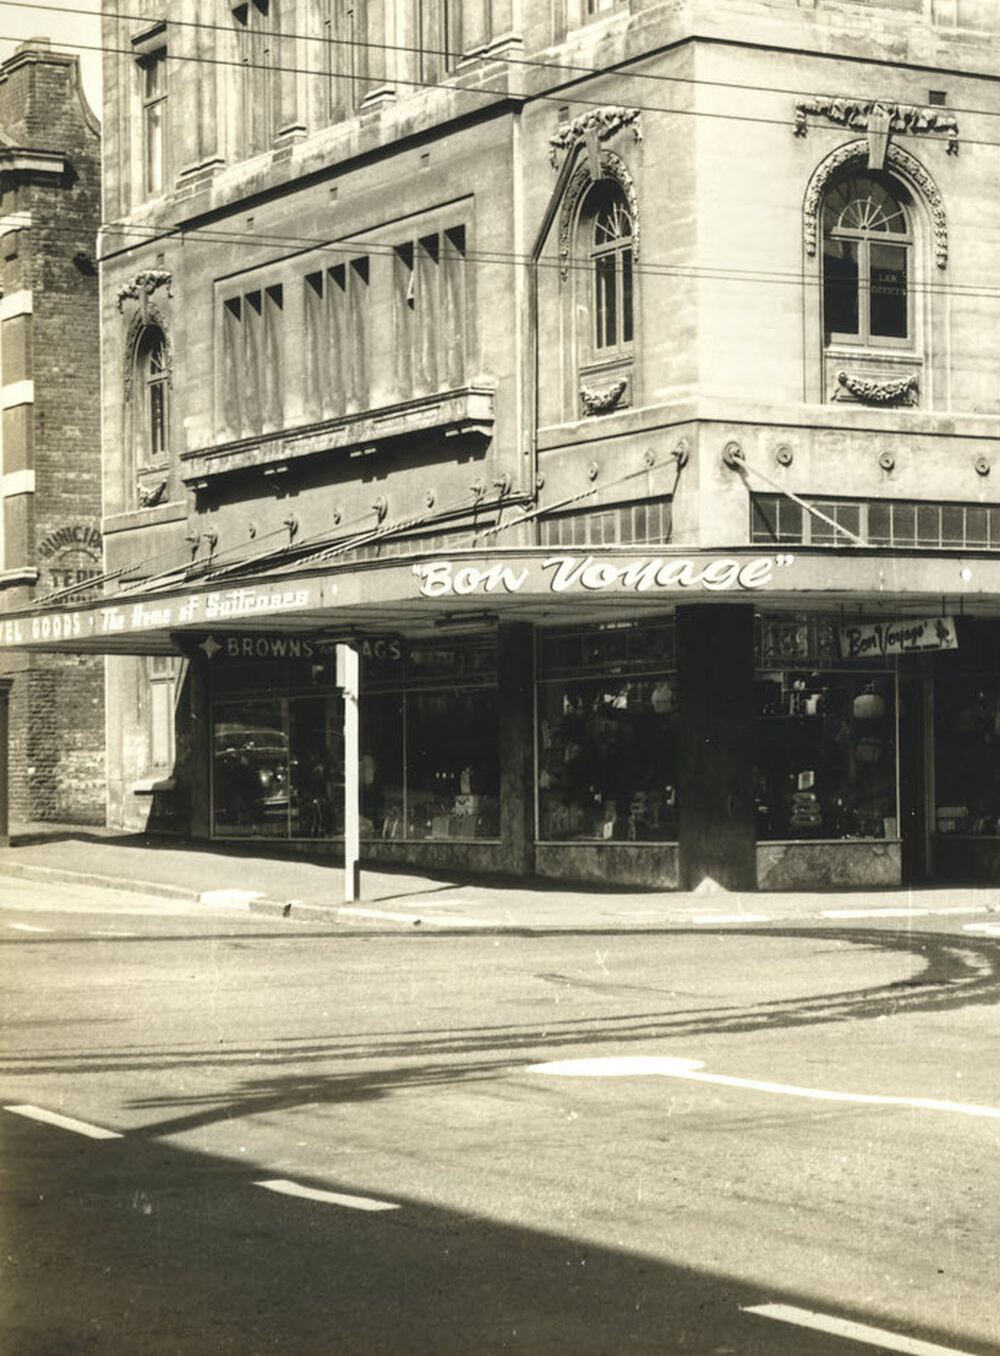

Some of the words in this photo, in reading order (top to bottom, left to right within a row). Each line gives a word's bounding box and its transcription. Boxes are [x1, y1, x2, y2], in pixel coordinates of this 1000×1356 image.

[0, 620, 22, 643] EL
[32, 611, 80, 639] GOODS
[101, 607, 124, 631] The
[132, 602, 170, 628] Home
[179, 596, 199, 621] of
[206, 589, 309, 617] Suitcases
[228, 637, 313, 658] BROWNS
[361, 640, 401, 661] AGS
